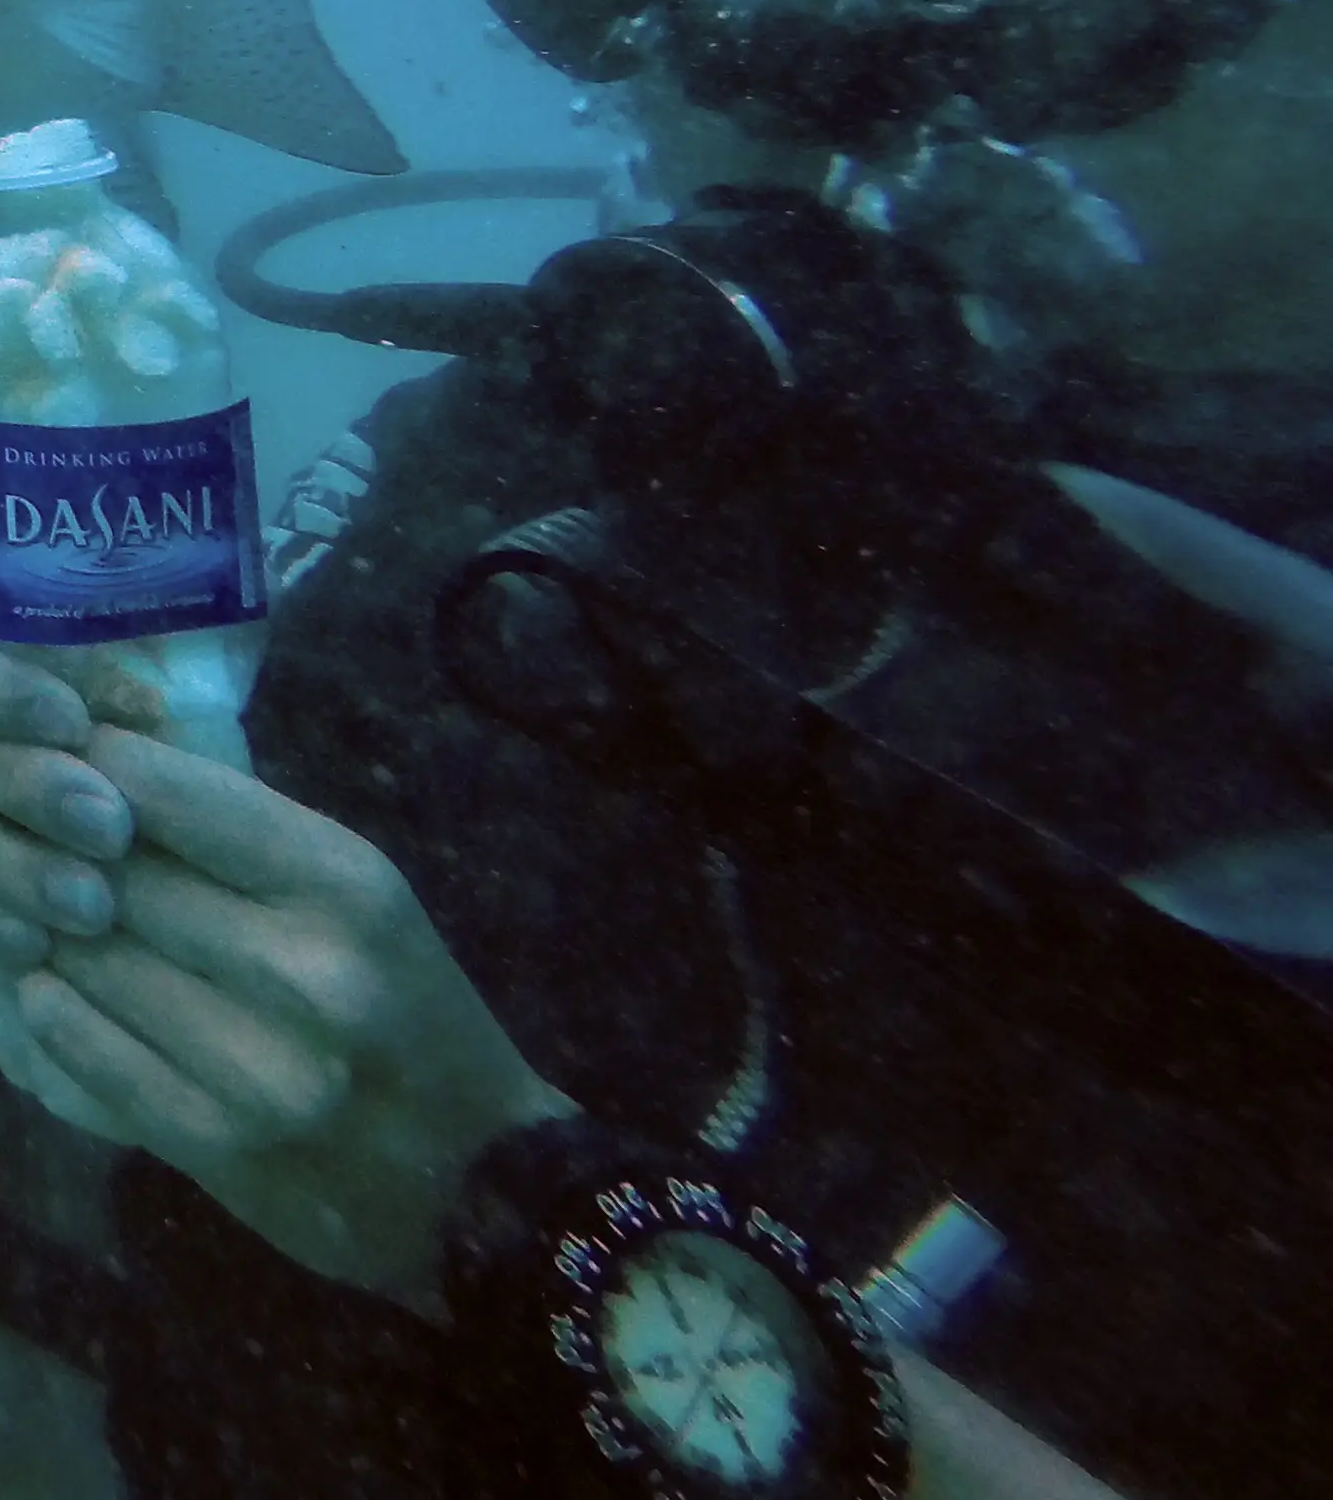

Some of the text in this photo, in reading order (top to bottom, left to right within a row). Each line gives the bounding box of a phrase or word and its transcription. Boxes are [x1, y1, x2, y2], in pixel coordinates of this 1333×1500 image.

[4, 441, 209, 467] DRINKING WATER
[5, 483, 214, 550] DASANI
